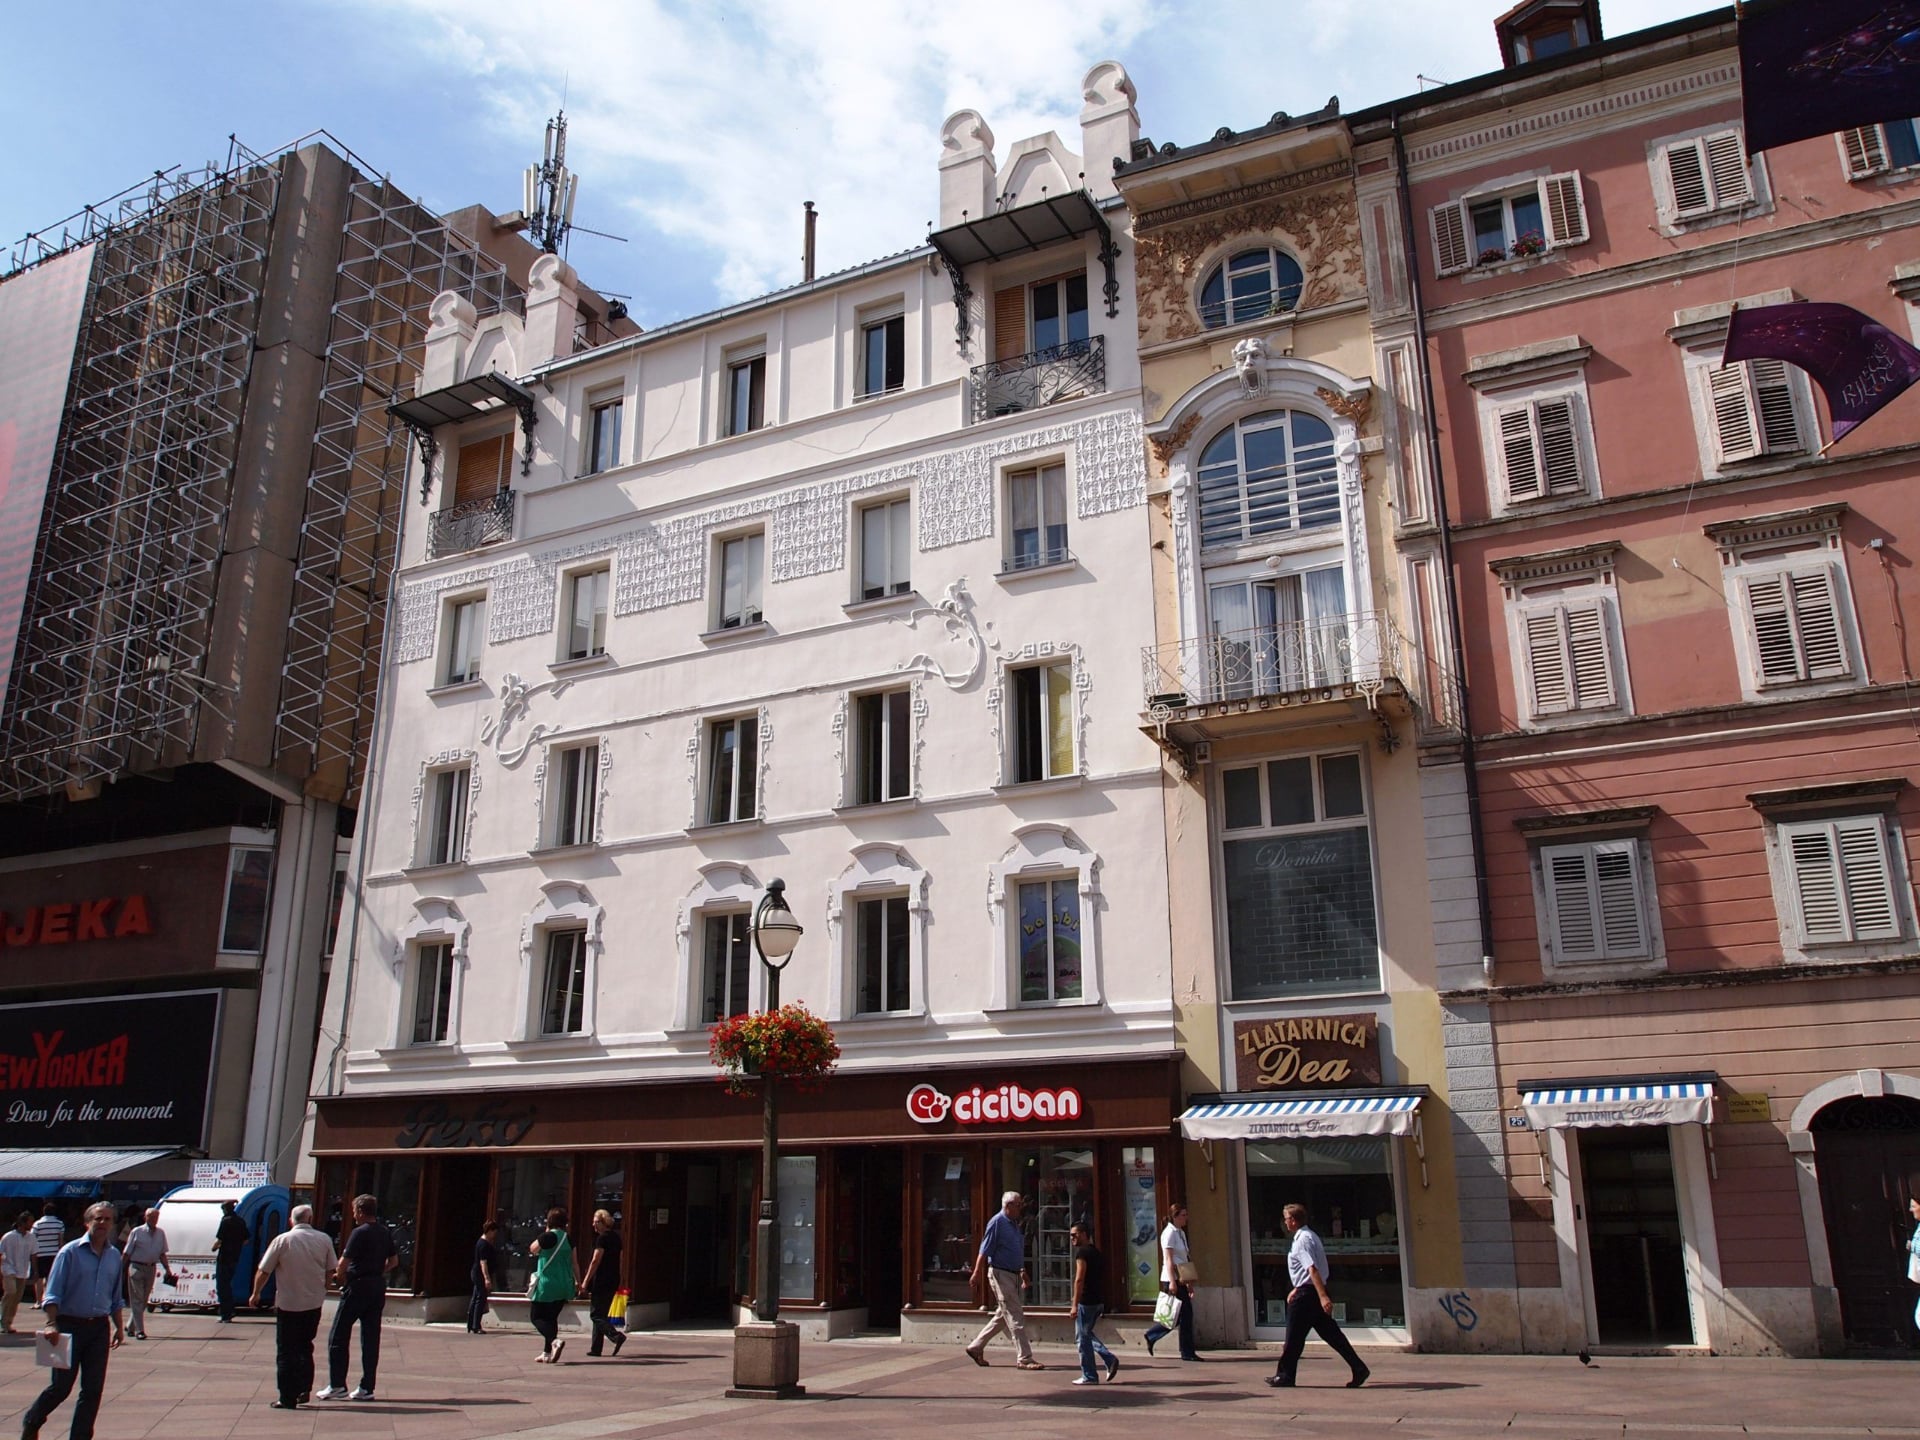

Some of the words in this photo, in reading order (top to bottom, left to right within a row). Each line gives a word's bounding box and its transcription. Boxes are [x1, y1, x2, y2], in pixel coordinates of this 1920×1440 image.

[1254, 841, 1337, 868] Domika
[0, 895, 151, 946] JEKA
[1238, 1018, 1367, 1056] ZLATARNICA
[1256, 1043, 1352, 1085] Dea
[5, 1100, 47, 1123] Dress
[46, 1100, 74, 1128] for
[78, 1100, 103, 1121] the
[106, 1101, 173, 1121] moment.
[954, 1085, 1078, 1120] ciciban
[1248, 1122, 1300, 1134] ZLATARNICA
[1305, 1119, 1339, 1133] Dea
